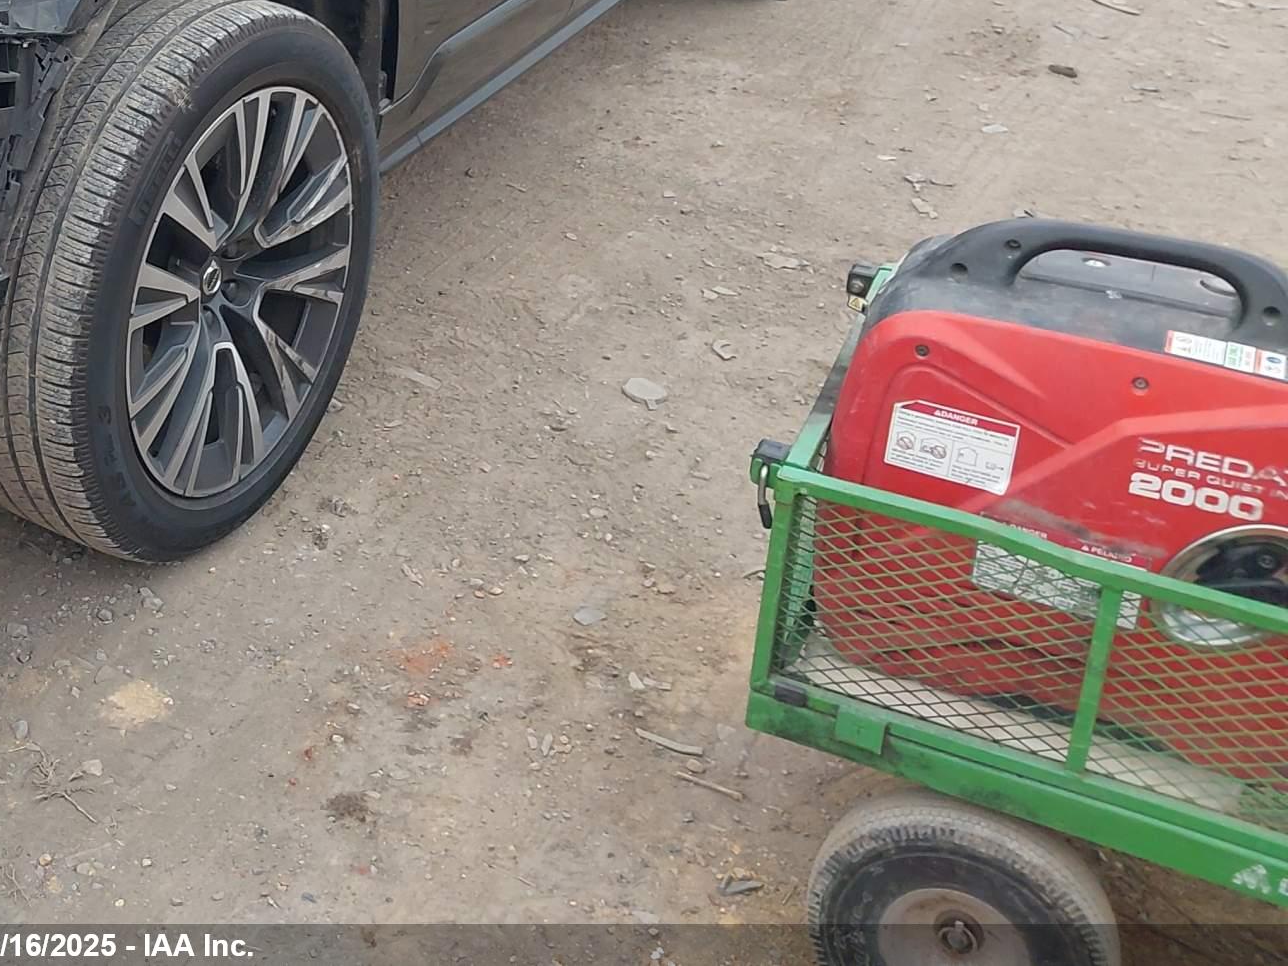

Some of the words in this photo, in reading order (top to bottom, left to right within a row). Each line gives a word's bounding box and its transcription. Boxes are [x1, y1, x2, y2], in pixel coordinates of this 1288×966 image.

[941, 410, 979, 427] DANGER
[1134, 458, 1201, 481] SUPER
[1206, 474, 1265, 495] QUIET
[1137, 436, 1288, 487] PREDA
[1128, 471, 1265, 522] 2000
